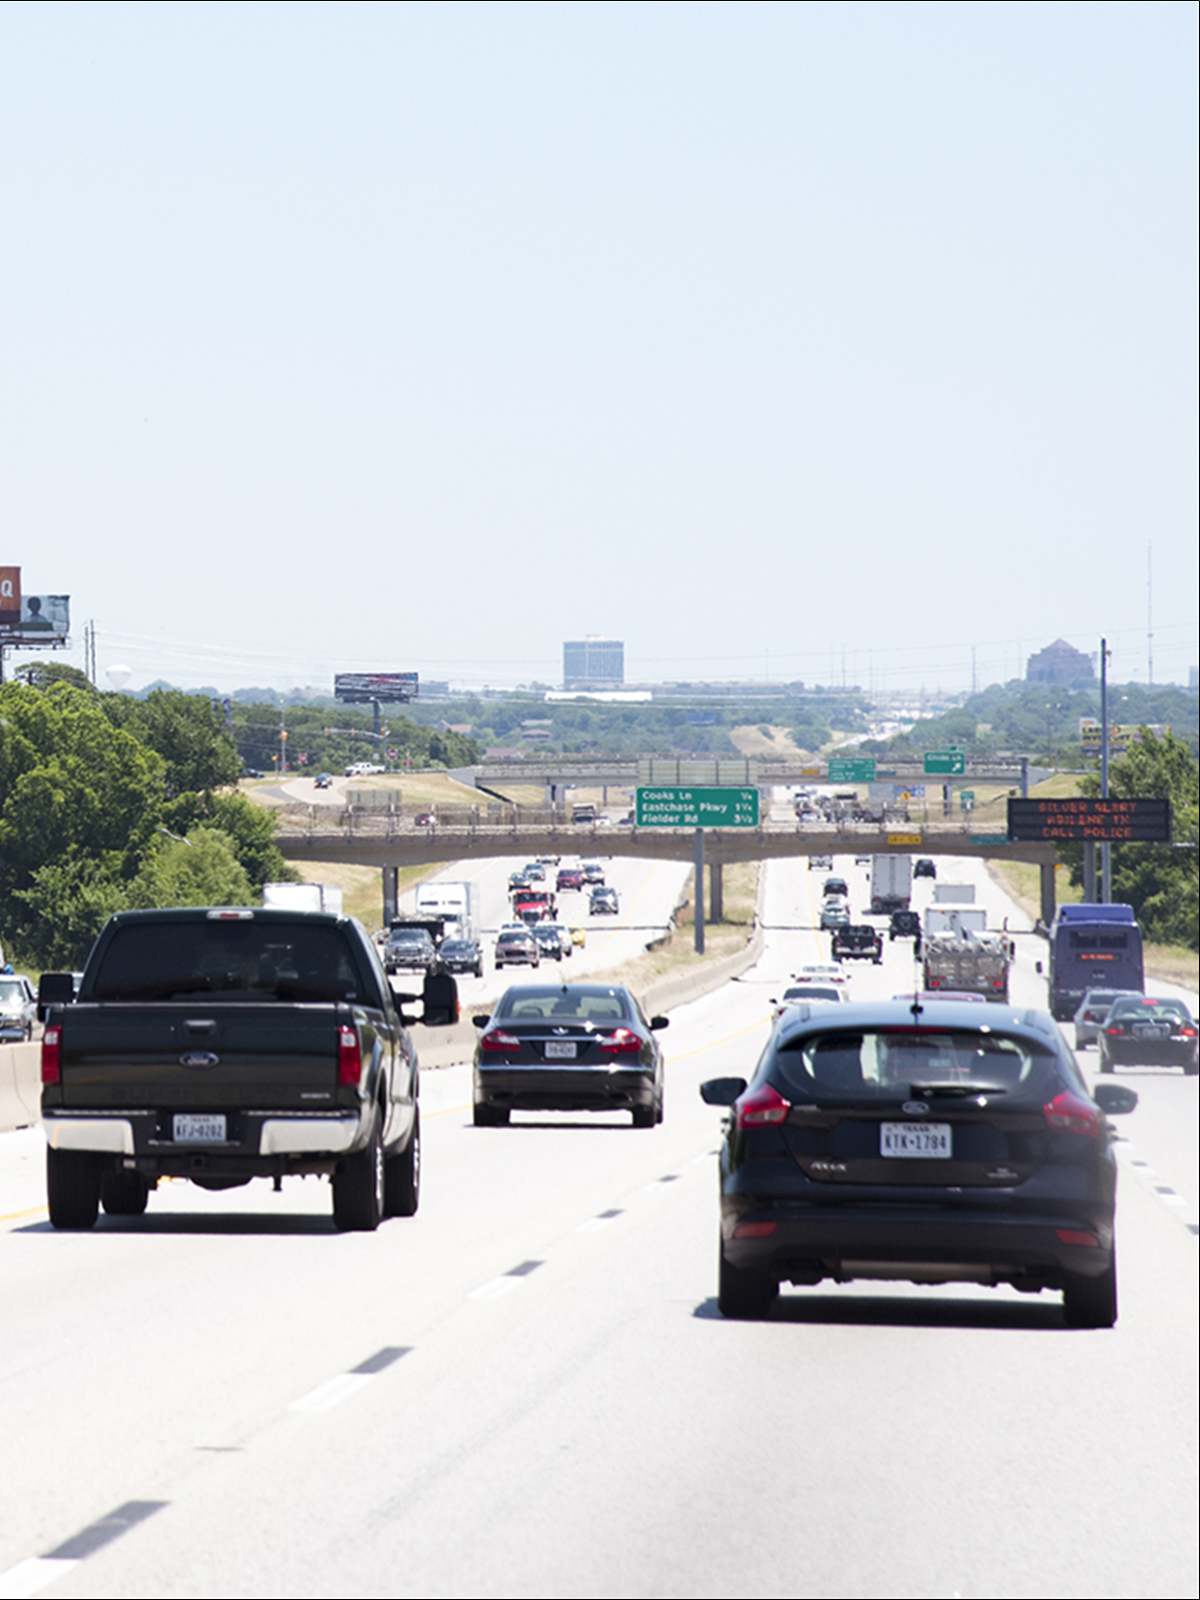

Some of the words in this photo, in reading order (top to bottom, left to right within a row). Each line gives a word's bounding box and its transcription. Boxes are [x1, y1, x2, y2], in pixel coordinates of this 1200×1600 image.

[642, 791, 674, 800] Cooks
[679, 792, 692, 800] Ln
[642, 803, 695, 812] Eastchase
[700, 803, 728, 814] Pkwy
[1038, 802, 1088, 813] SILVER
[1094, 802, 1137, 813] ALERT
[642, 814, 680, 823] Fielder
[684, 815, 698, 823] Rd
[1047, 814, 1105, 826] ABILENE
[1113, 815, 1130, 825] TX
[1042, 827, 1075, 838] CALL
[1083, 827, 1133, 838] POLICE
